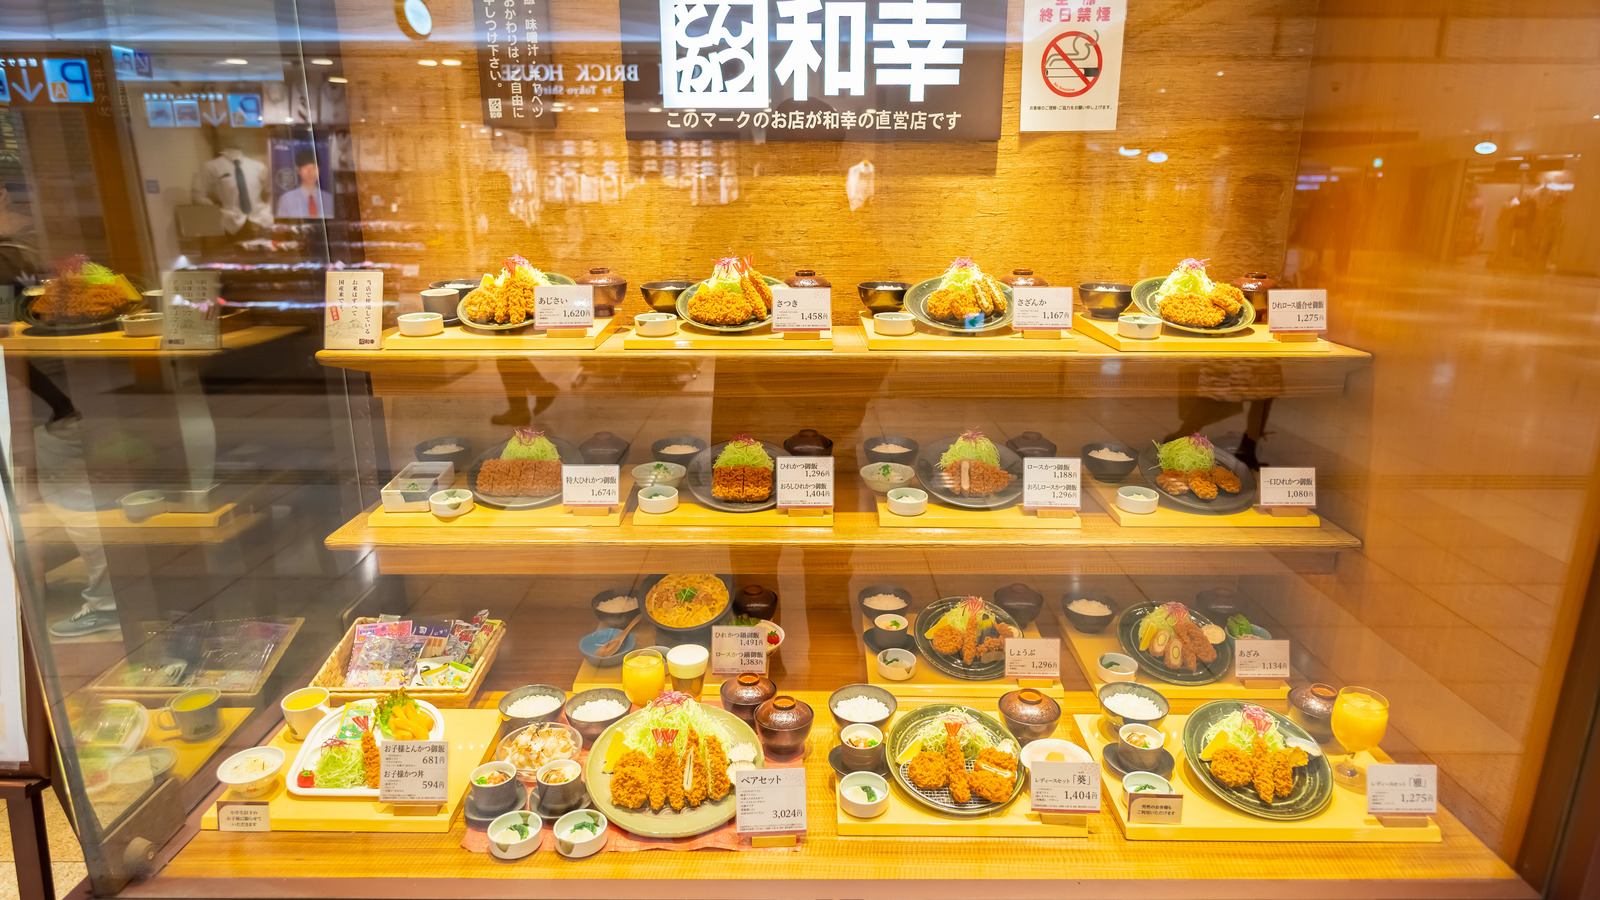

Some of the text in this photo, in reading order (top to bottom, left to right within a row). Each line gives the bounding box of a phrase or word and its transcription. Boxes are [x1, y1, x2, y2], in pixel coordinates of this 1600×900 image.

[1039, 7, 1111, 22] 終日禁煙
[774, 0, 967, 102] 和幸
[667, 111, 962, 130] このマークのお店が和幸の直営店です
[538, 296, 569, 305] あじさい
[776, 299, 798, 308] さつき
[1017, 298, 1047, 307] さざんか
[1271, 301, 1325, 310] ひれロース盛合せ御飯
[562, 309, 591, 318] 1,620円
[800, 312, 829, 321] 1,458円
[1042, 311, 1070, 319] 1,167円
[1297, 314, 1325, 322] 1,275円
[1053, 471, 1078, 479] 1,188円
[566, 476, 617, 485] 特大ひれかつ御飯
[1263, 478, 1313, 486] 一口ひれかつ御飯
[591, 488, 617, 497] 1,674円
[805, 490, 830, 498] 1,404円
[1052, 491, 1078, 499] 1,296円
[1287, 490, 1314, 498] 1,080円
[715, 651, 764, 659] ロースかつ鍋御飯
[1009, 648, 1036, 656] しょうぶ
[1238, 650, 1260, 658] あざみ
[740, 658, 764, 666] 1,383円
[1031, 661, 1058, 669] 1,296円
[1261, 662, 1288, 670] 1,134円
[384, 744, 446, 753] お子様とんかつ御飯
[422, 756, 446, 765] 681円
[383, 769, 425, 779] お子様かつ丼
[741, 774, 782, 785] ペアセット
[422, 780, 445, 789] 594円
[1064, 790, 1098, 800] 1,404円
[1400, 794, 1434, 802] 1,275円
[772, 808, 803, 818] 3,024円
